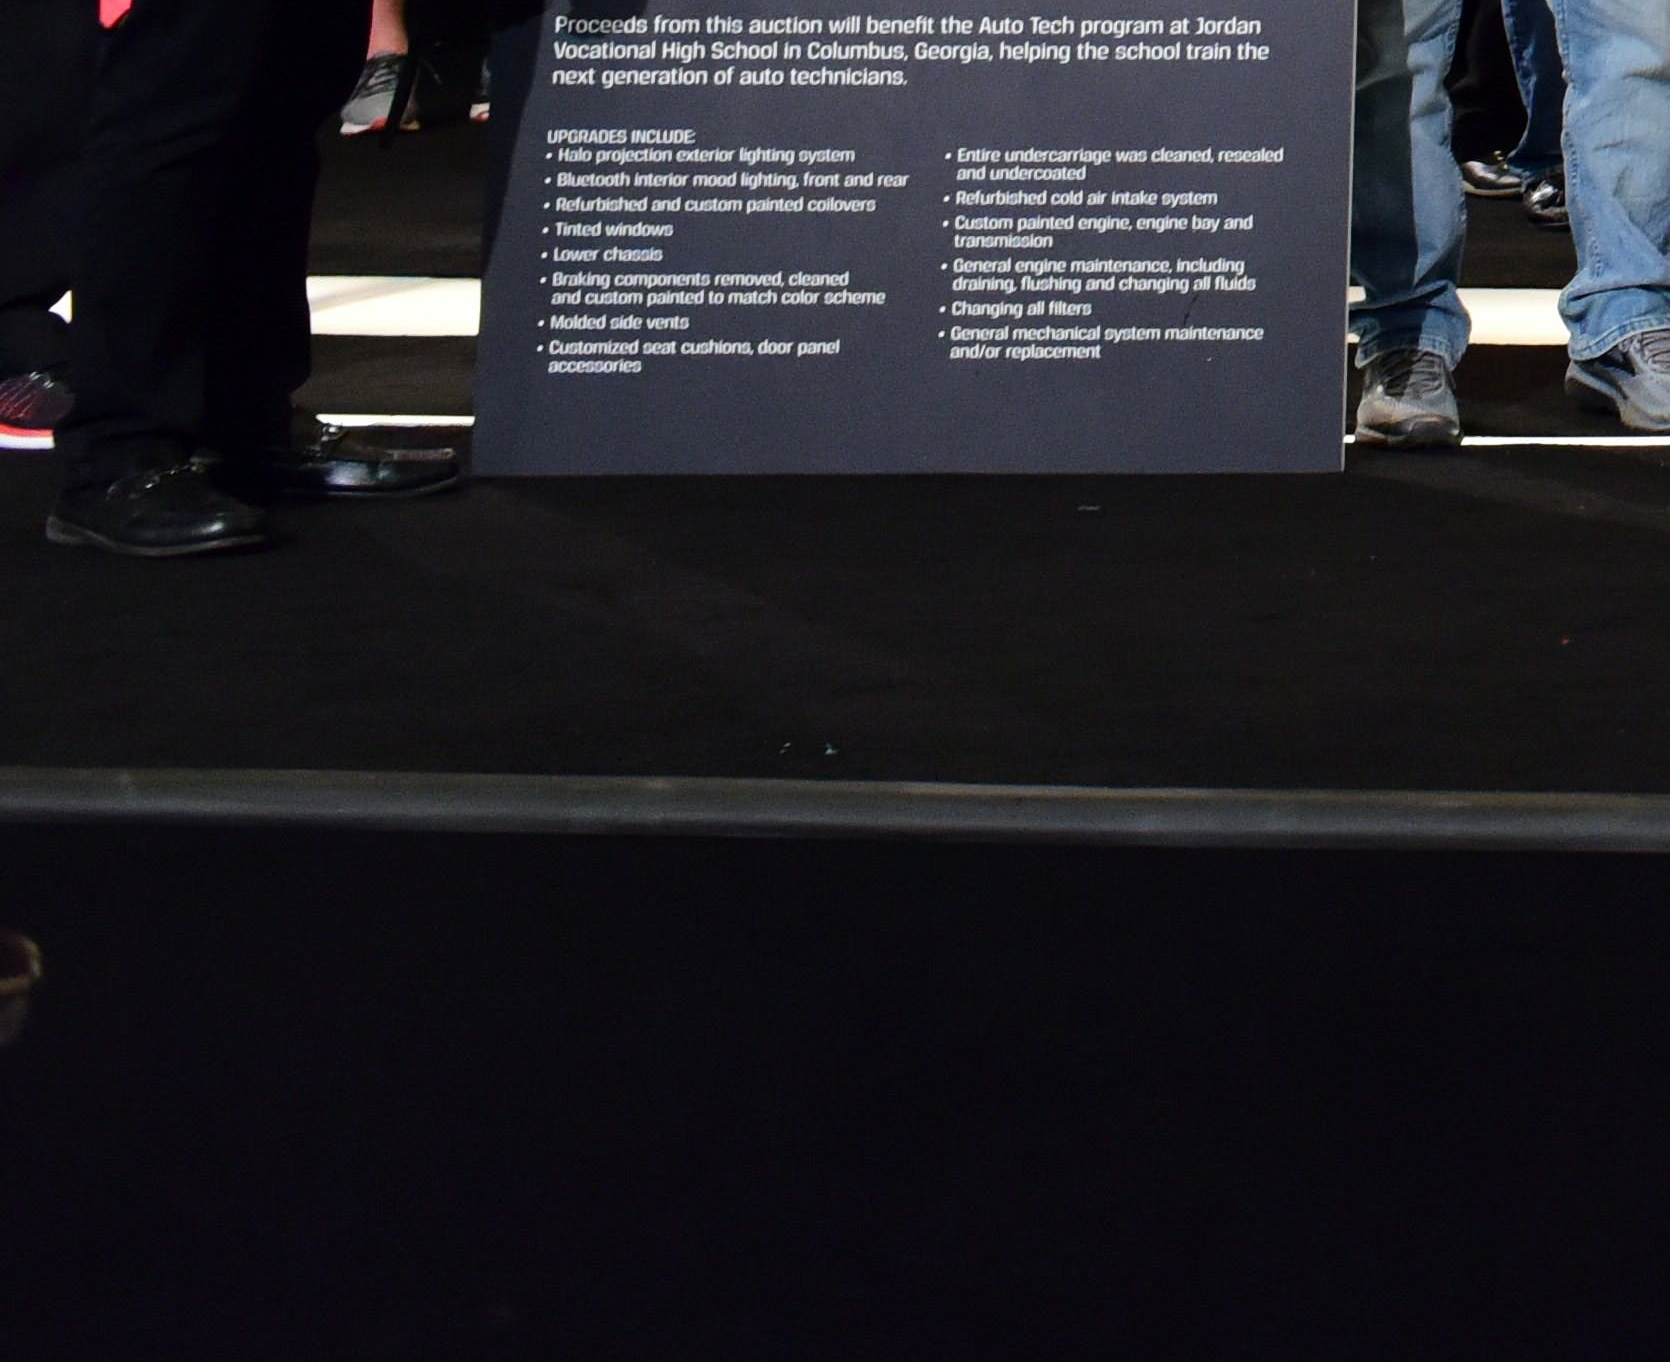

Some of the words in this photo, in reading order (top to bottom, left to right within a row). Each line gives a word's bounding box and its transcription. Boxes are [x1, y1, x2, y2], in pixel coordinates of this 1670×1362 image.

[552, 68, 596, 86] next
[601, 67, 708, 89] generation
[713, 66, 735, 86] of
[739, 68, 785, 86] auto
[790, 66, 908, 86] technicians.
[956, 165, 986, 181] and
[989, 165, 1087, 181] undercoated
[555, 221, 602, 237] Tinted
[605, 221, 674, 237] windows
[954, 234, 1054, 249] transmission
[553, 247, 600, 262] Lower
[603, 246, 664, 262] chassis
[951, 300, 1024, 319] Changing
[1026, 300, 1045, 316] all
[1048, 300, 1092, 316] filters
[550, 314, 607, 330] Molded
[610, 314, 643, 330] side
[646, 316, 690, 330] vents
[950, 343, 1002, 359] and/or
[1005, 344, 1101, 362] replacement
[548, 358, 642, 374] accessories
